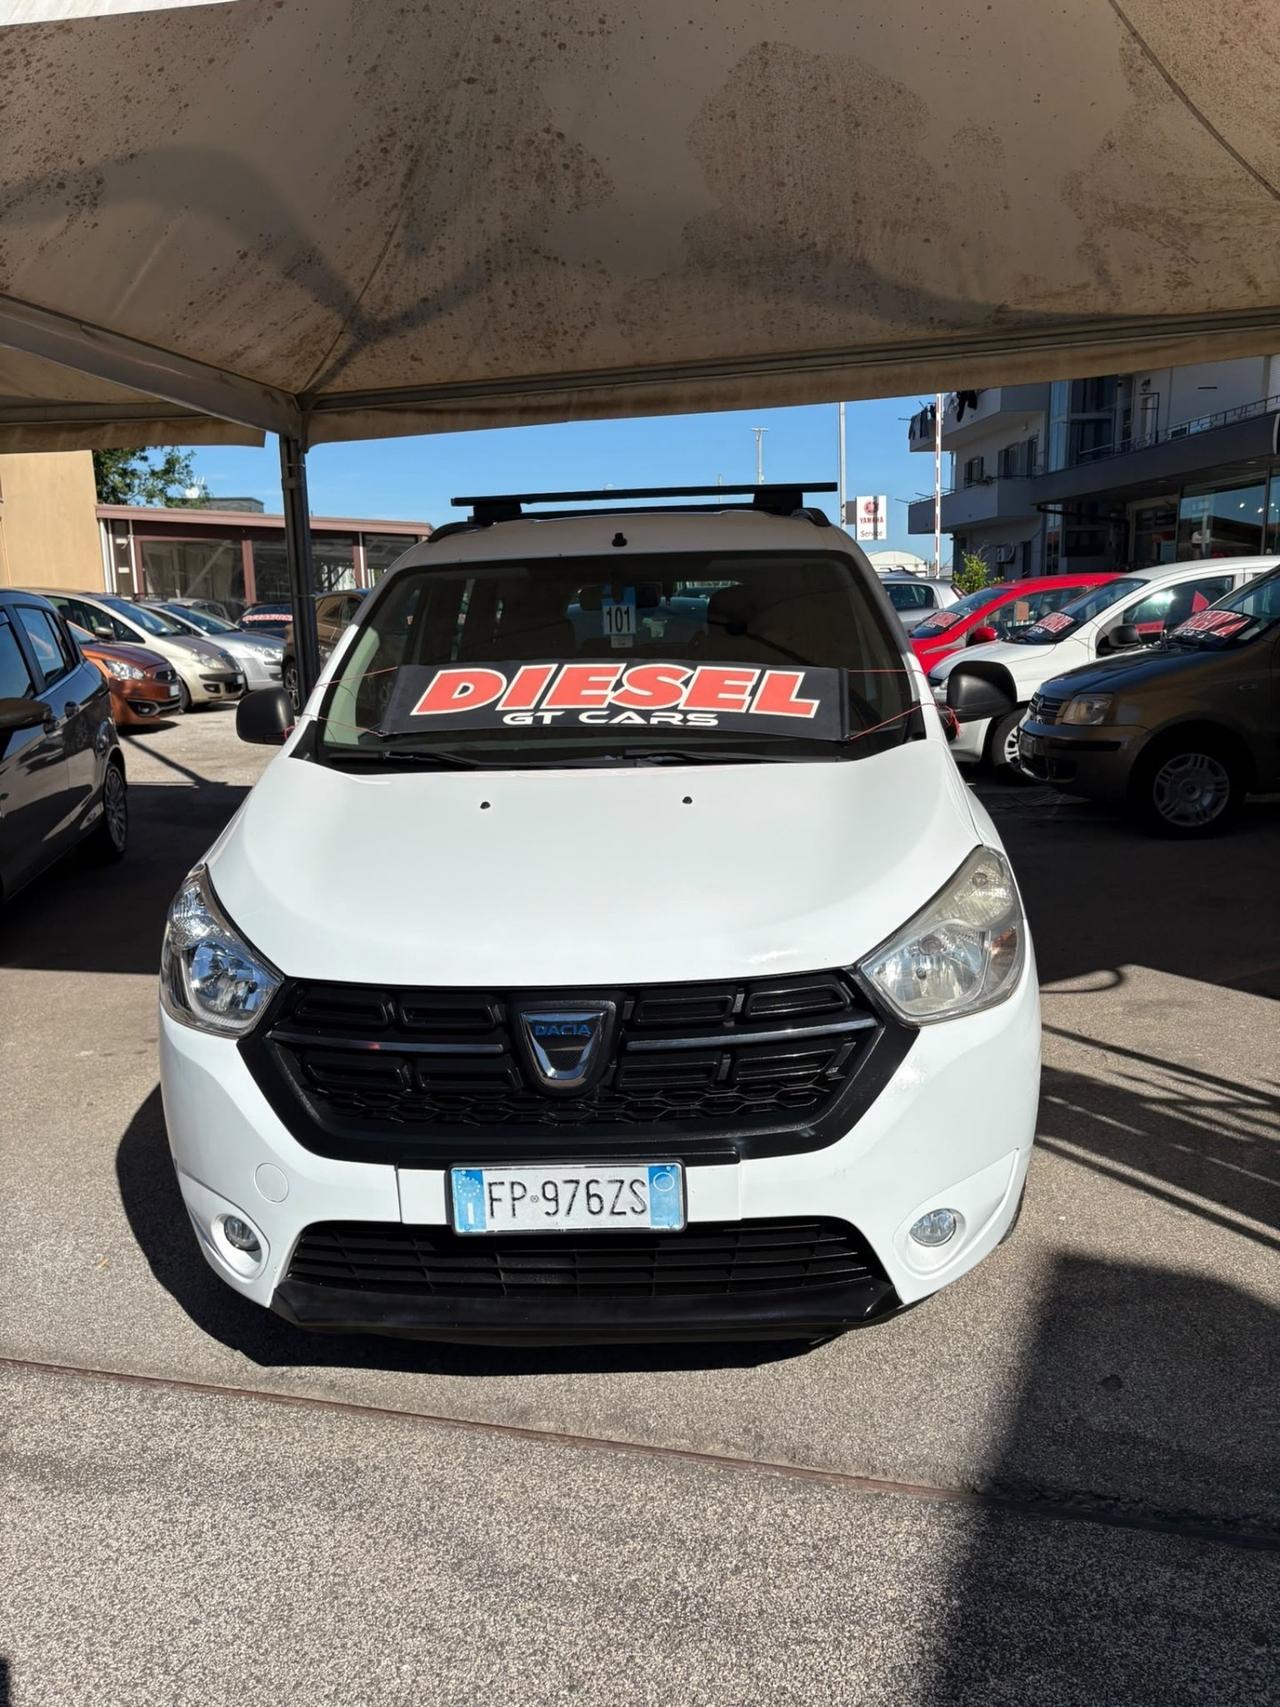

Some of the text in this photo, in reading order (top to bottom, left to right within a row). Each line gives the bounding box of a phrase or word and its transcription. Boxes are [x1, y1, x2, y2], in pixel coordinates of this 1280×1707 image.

[606, 606, 630, 633] 101
[410, 663, 820, 719] DIESEL
[502, 709, 720, 726] GT CARS
[534, 1023, 593, 1037] DACIA
[487, 1178, 648, 1219] FP 976ZS
